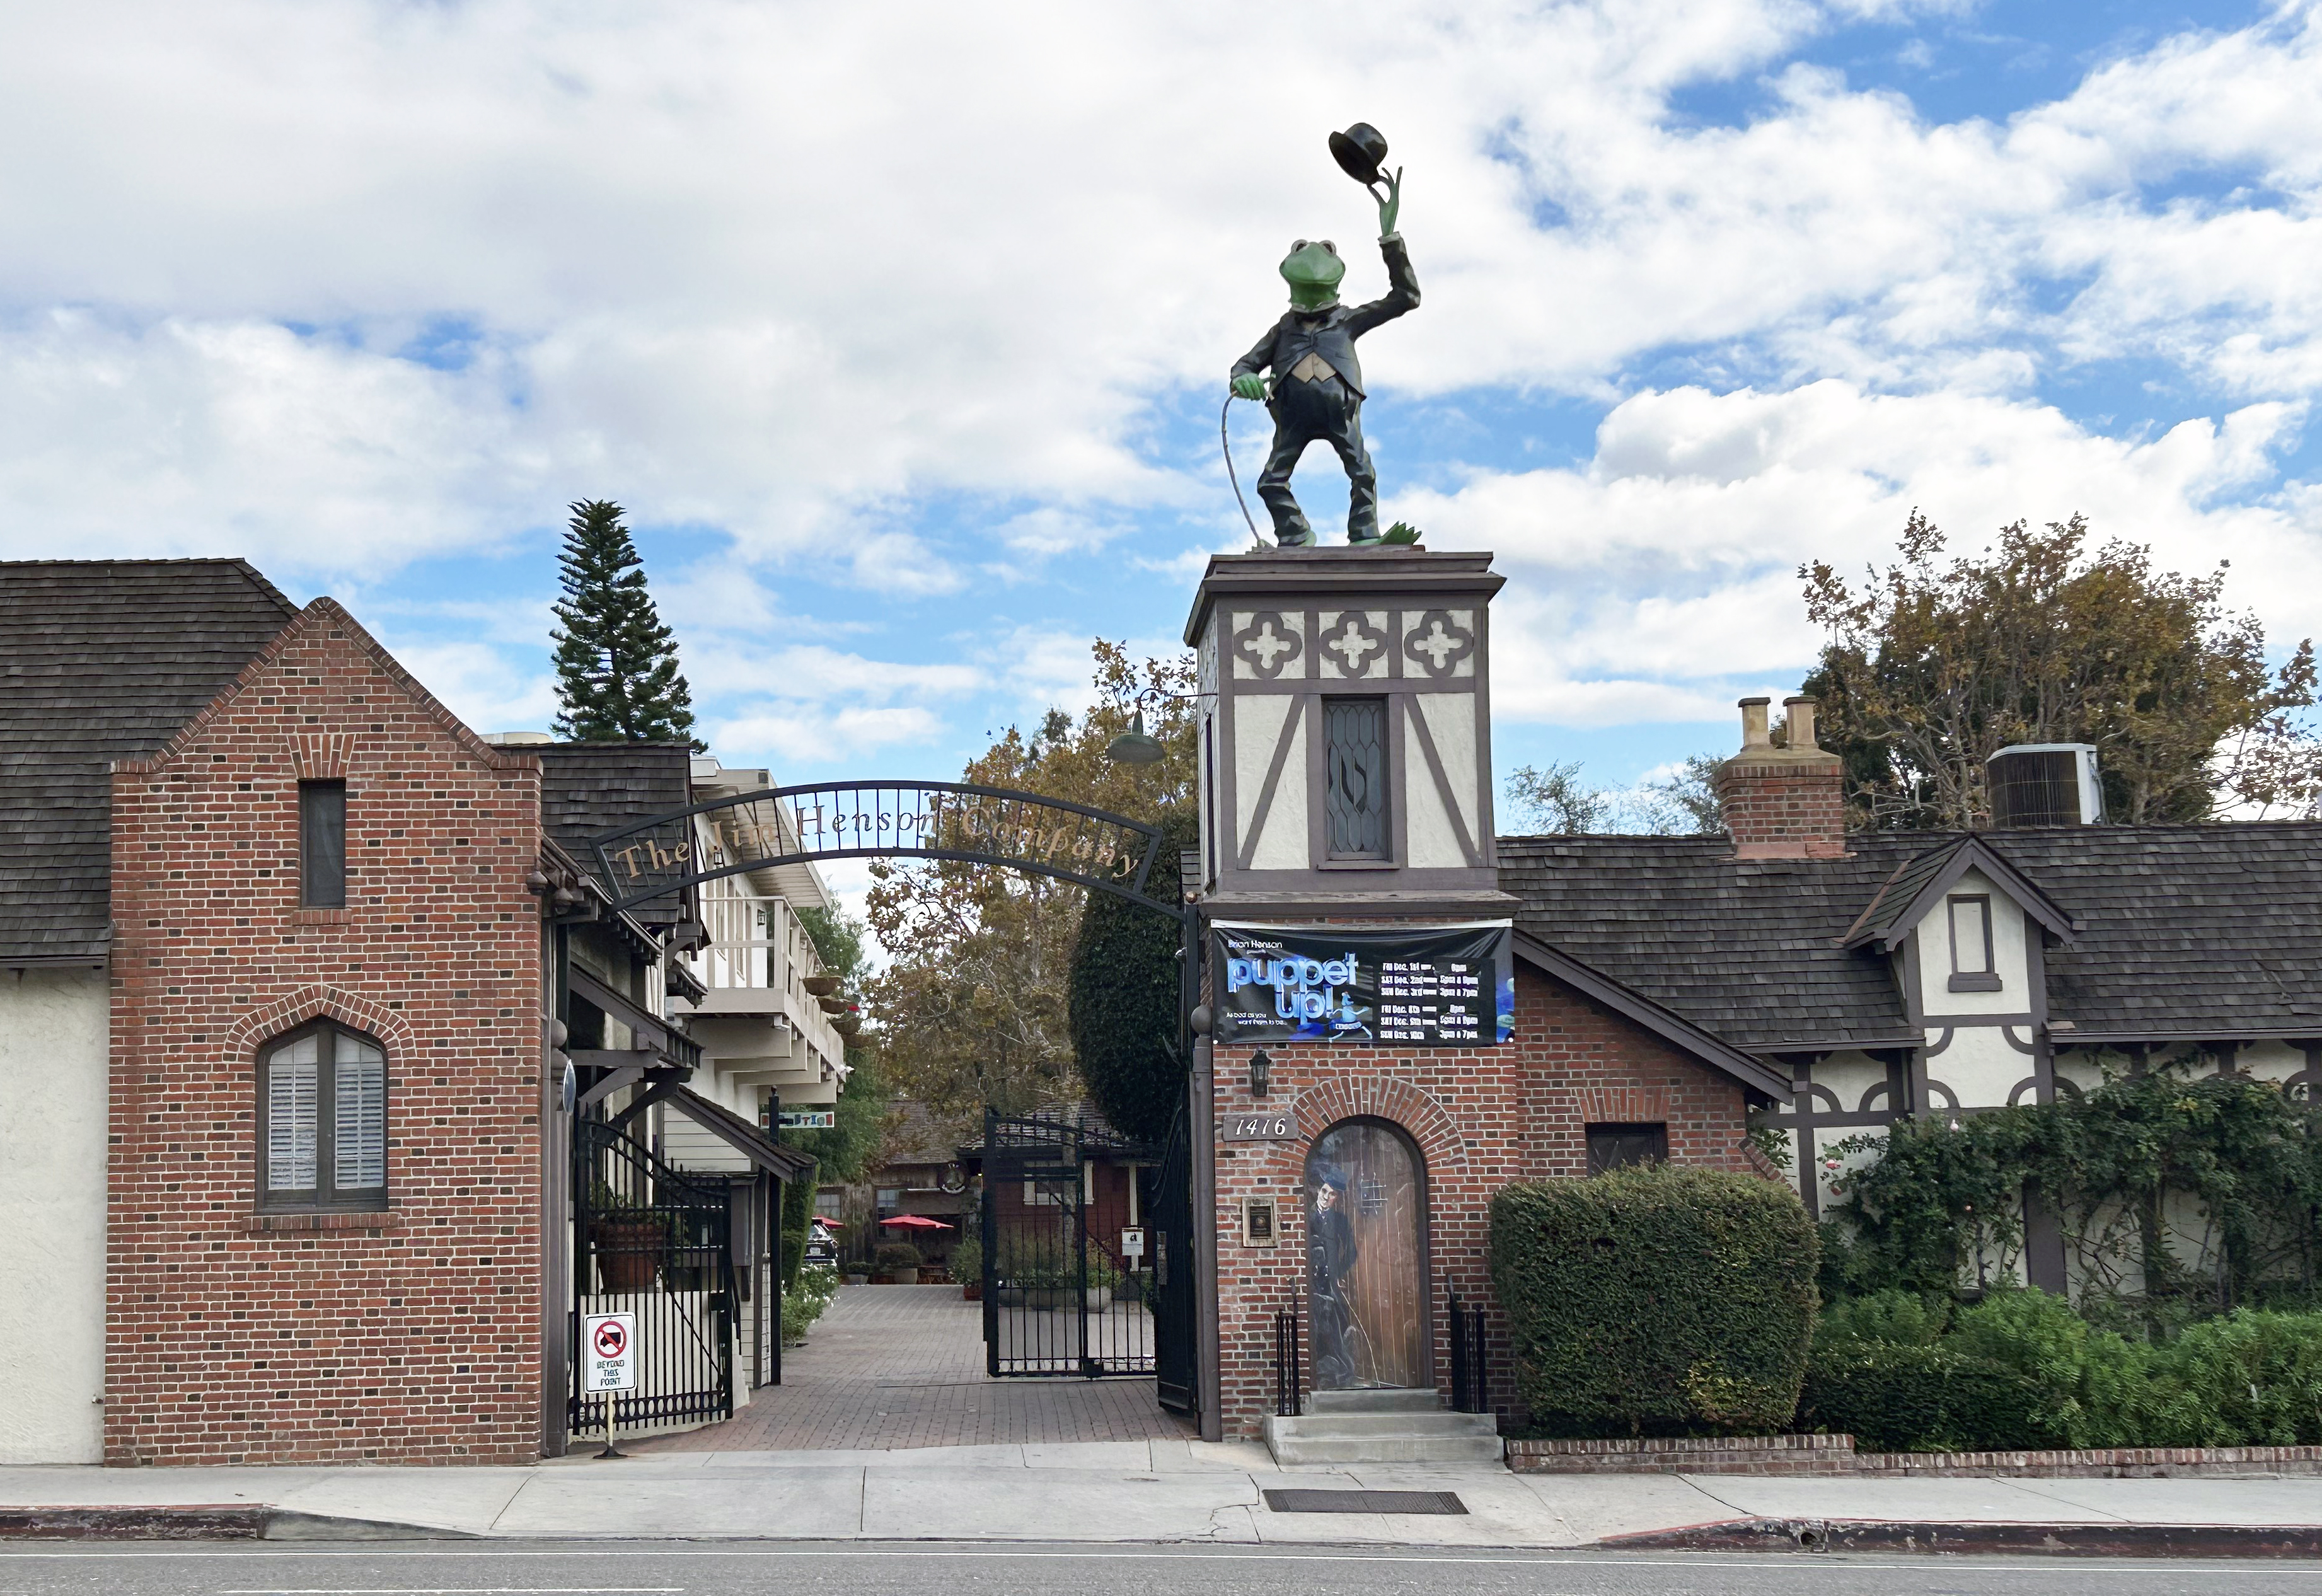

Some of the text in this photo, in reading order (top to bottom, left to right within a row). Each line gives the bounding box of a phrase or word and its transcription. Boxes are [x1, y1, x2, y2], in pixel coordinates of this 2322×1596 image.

[615, 805, 1139, 879] The Jim Henson Company
[1251, 940, 1283, 948] Henson
[1227, 952, 1359, 993] puppet
[1274, 985, 1334, 1026] up!
[1236, 1118, 1286, 1135] 1416
[597, 1360, 625, 1368] BEYOND
[603, 1368, 619, 1377] THIS
[601, 1377, 621, 1386] POINT
